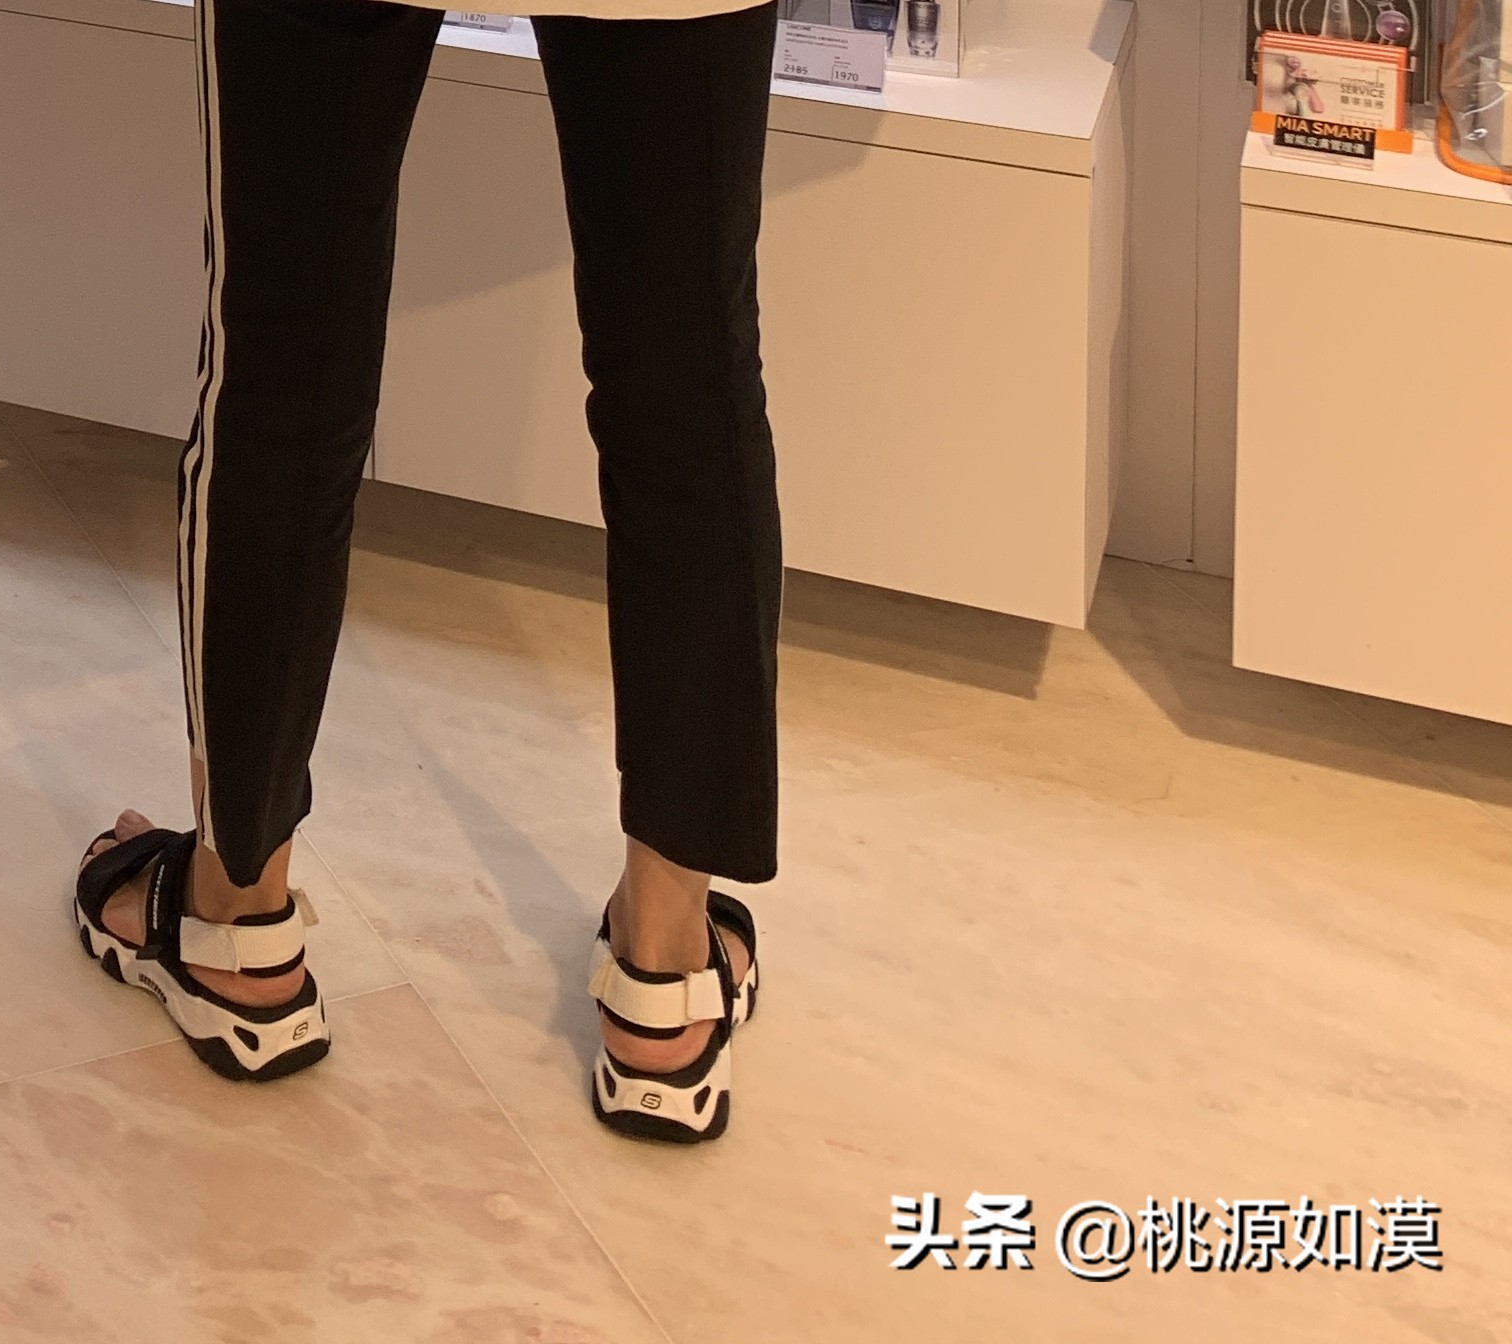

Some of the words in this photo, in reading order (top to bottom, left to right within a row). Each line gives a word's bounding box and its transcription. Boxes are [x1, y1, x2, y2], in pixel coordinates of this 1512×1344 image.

[835, 71, 859, 82] 1970
[1277, 117, 1310, 133] MIA
[1312, 122, 1375, 142] SMART
